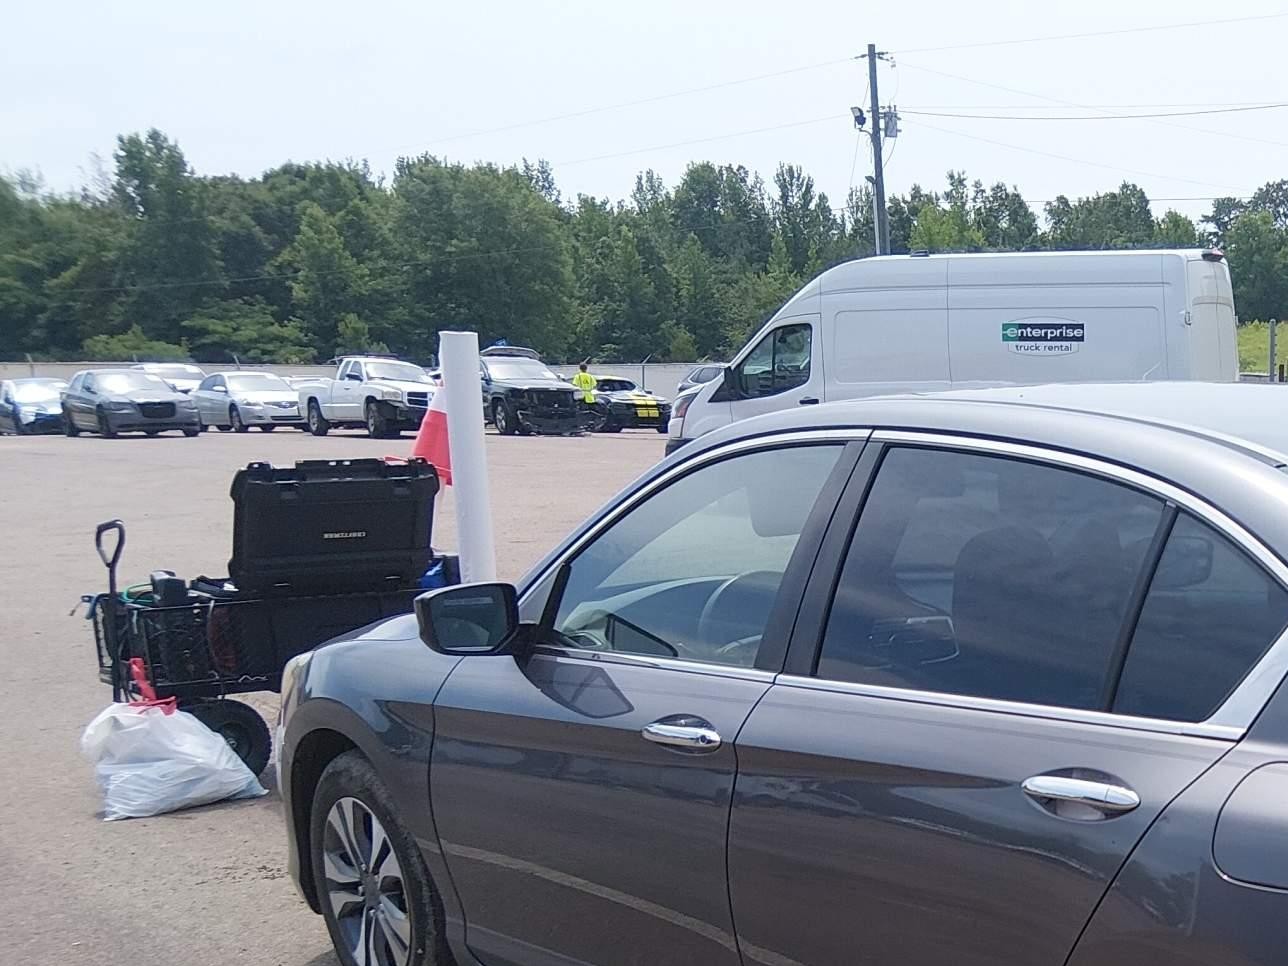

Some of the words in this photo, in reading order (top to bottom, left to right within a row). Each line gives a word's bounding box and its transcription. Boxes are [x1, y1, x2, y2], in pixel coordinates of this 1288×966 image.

[1003, 326, 1083, 340] enterprise
[1015, 343, 1041, 352] truck
[1043, 343, 1072, 352] rental
